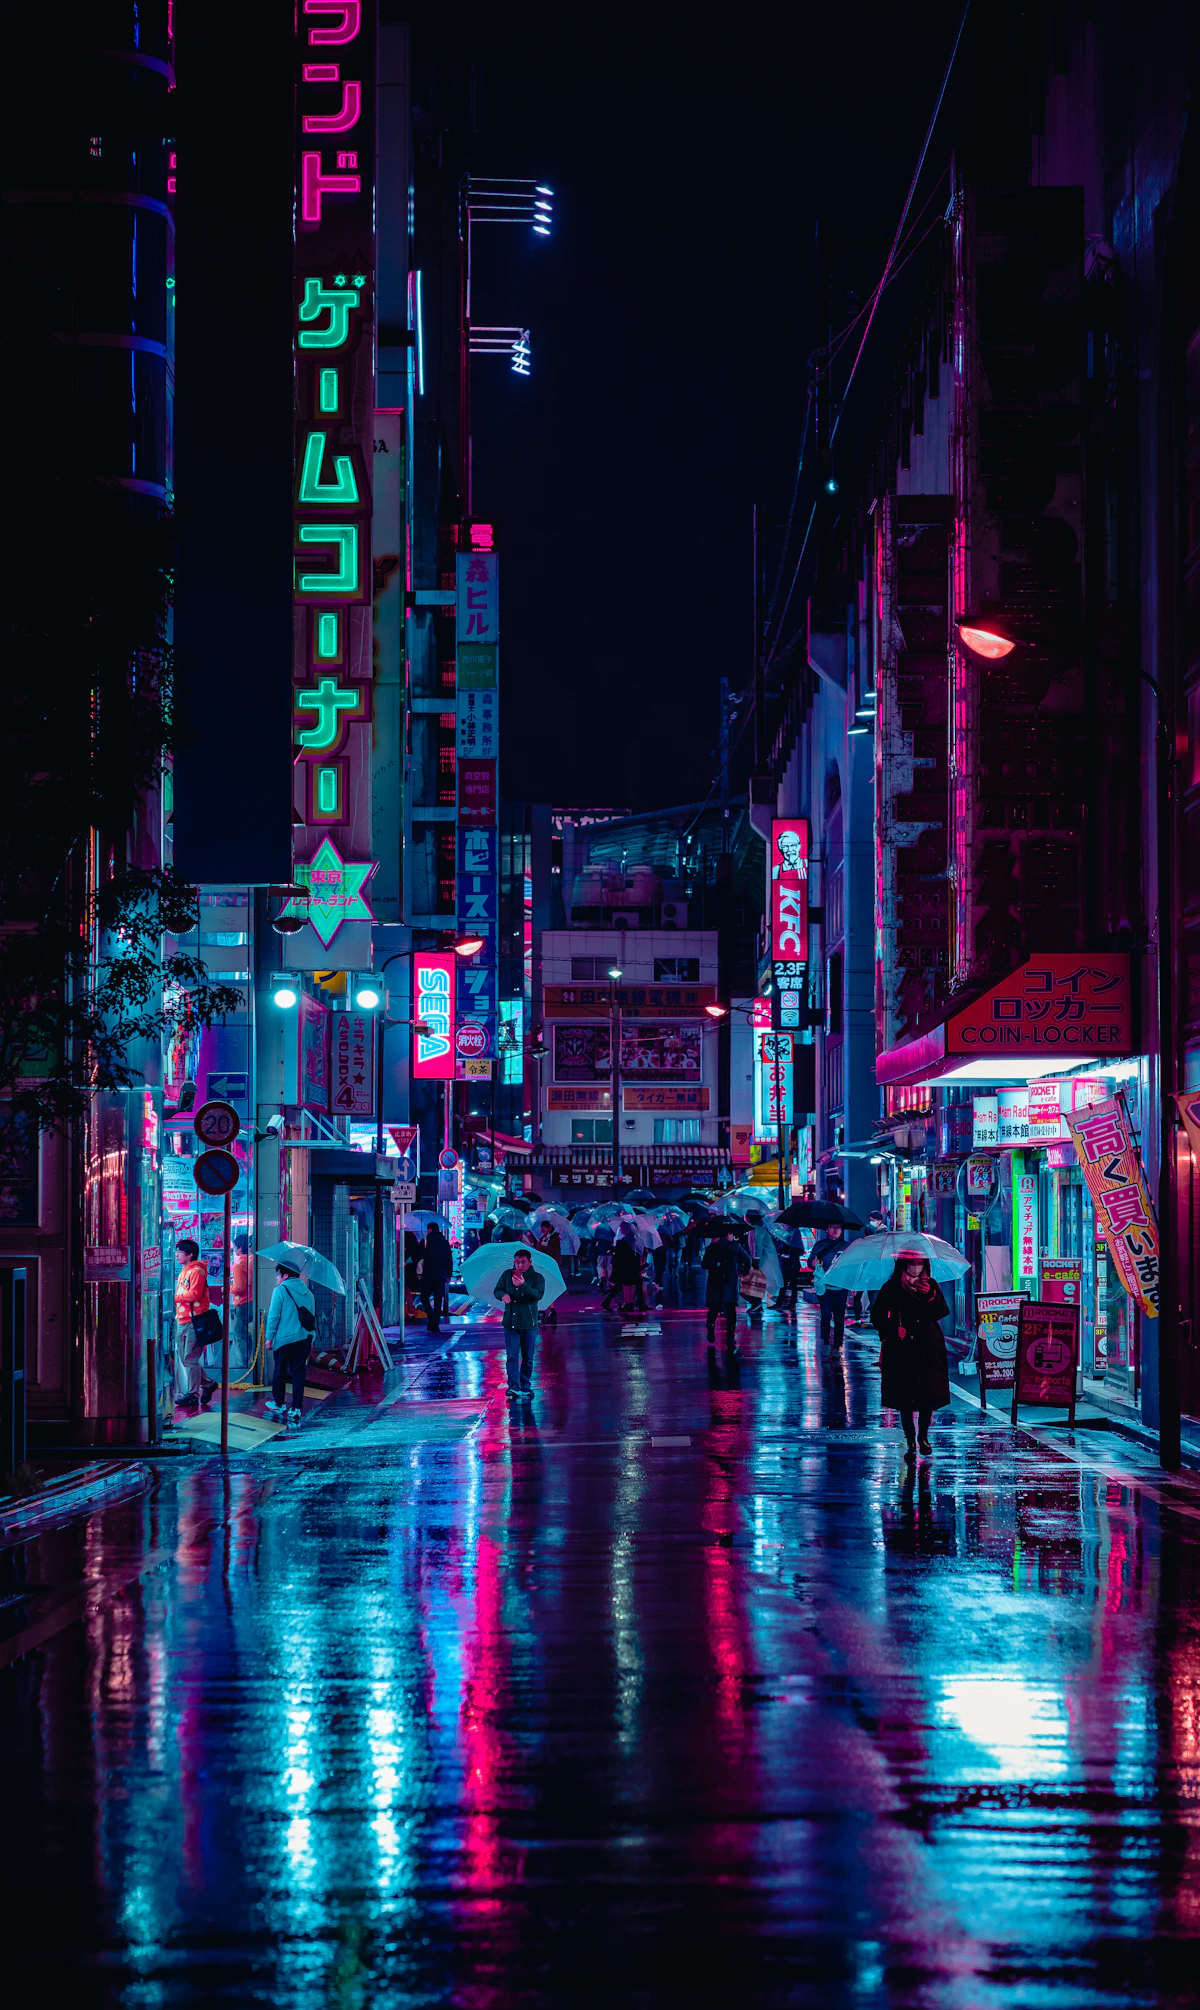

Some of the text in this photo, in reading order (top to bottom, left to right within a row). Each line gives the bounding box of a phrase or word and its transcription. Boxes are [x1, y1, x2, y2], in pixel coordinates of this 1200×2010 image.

[298, 275, 362, 813] ゲームコーナー
[469, 523, 494, 552] 電
[465, 558, 490, 635] 森ビル
[311, 869, 342, 884] 東京
[780, 885, 801, 953] KFC
[774, 962, 806, 976] 2,3F
[777, 977, 804, 990] 客席
[1022, 965, 1124, 995] コイン
[418, 967, 451, 1064] SEGA
[991, 995, 1124, 1022] ロッカー
[353, 1016, 365, 1069] キラキラ
[457, 1034, 483, 1047] 消火栓
[960, 1024, 1122, 1045] COIN-LOCKER
[636, 1093, 698, 1103] タイガー無線
[769, 1066, 787, 1122] お弁当
[205, 1115, 230, 1134] 20
[654, 1175, 713, 1185] タイガー無線
[1023, 1196, 1034, 1274] アマチュア無線本館
[1043, 1269, 1080, 1280] e-café
[981, 1313, 998, 1323] 3F
[1034, 1309, 1076, 1317] ROCKET
[1024, 1323, 1042, 1335] 2F
